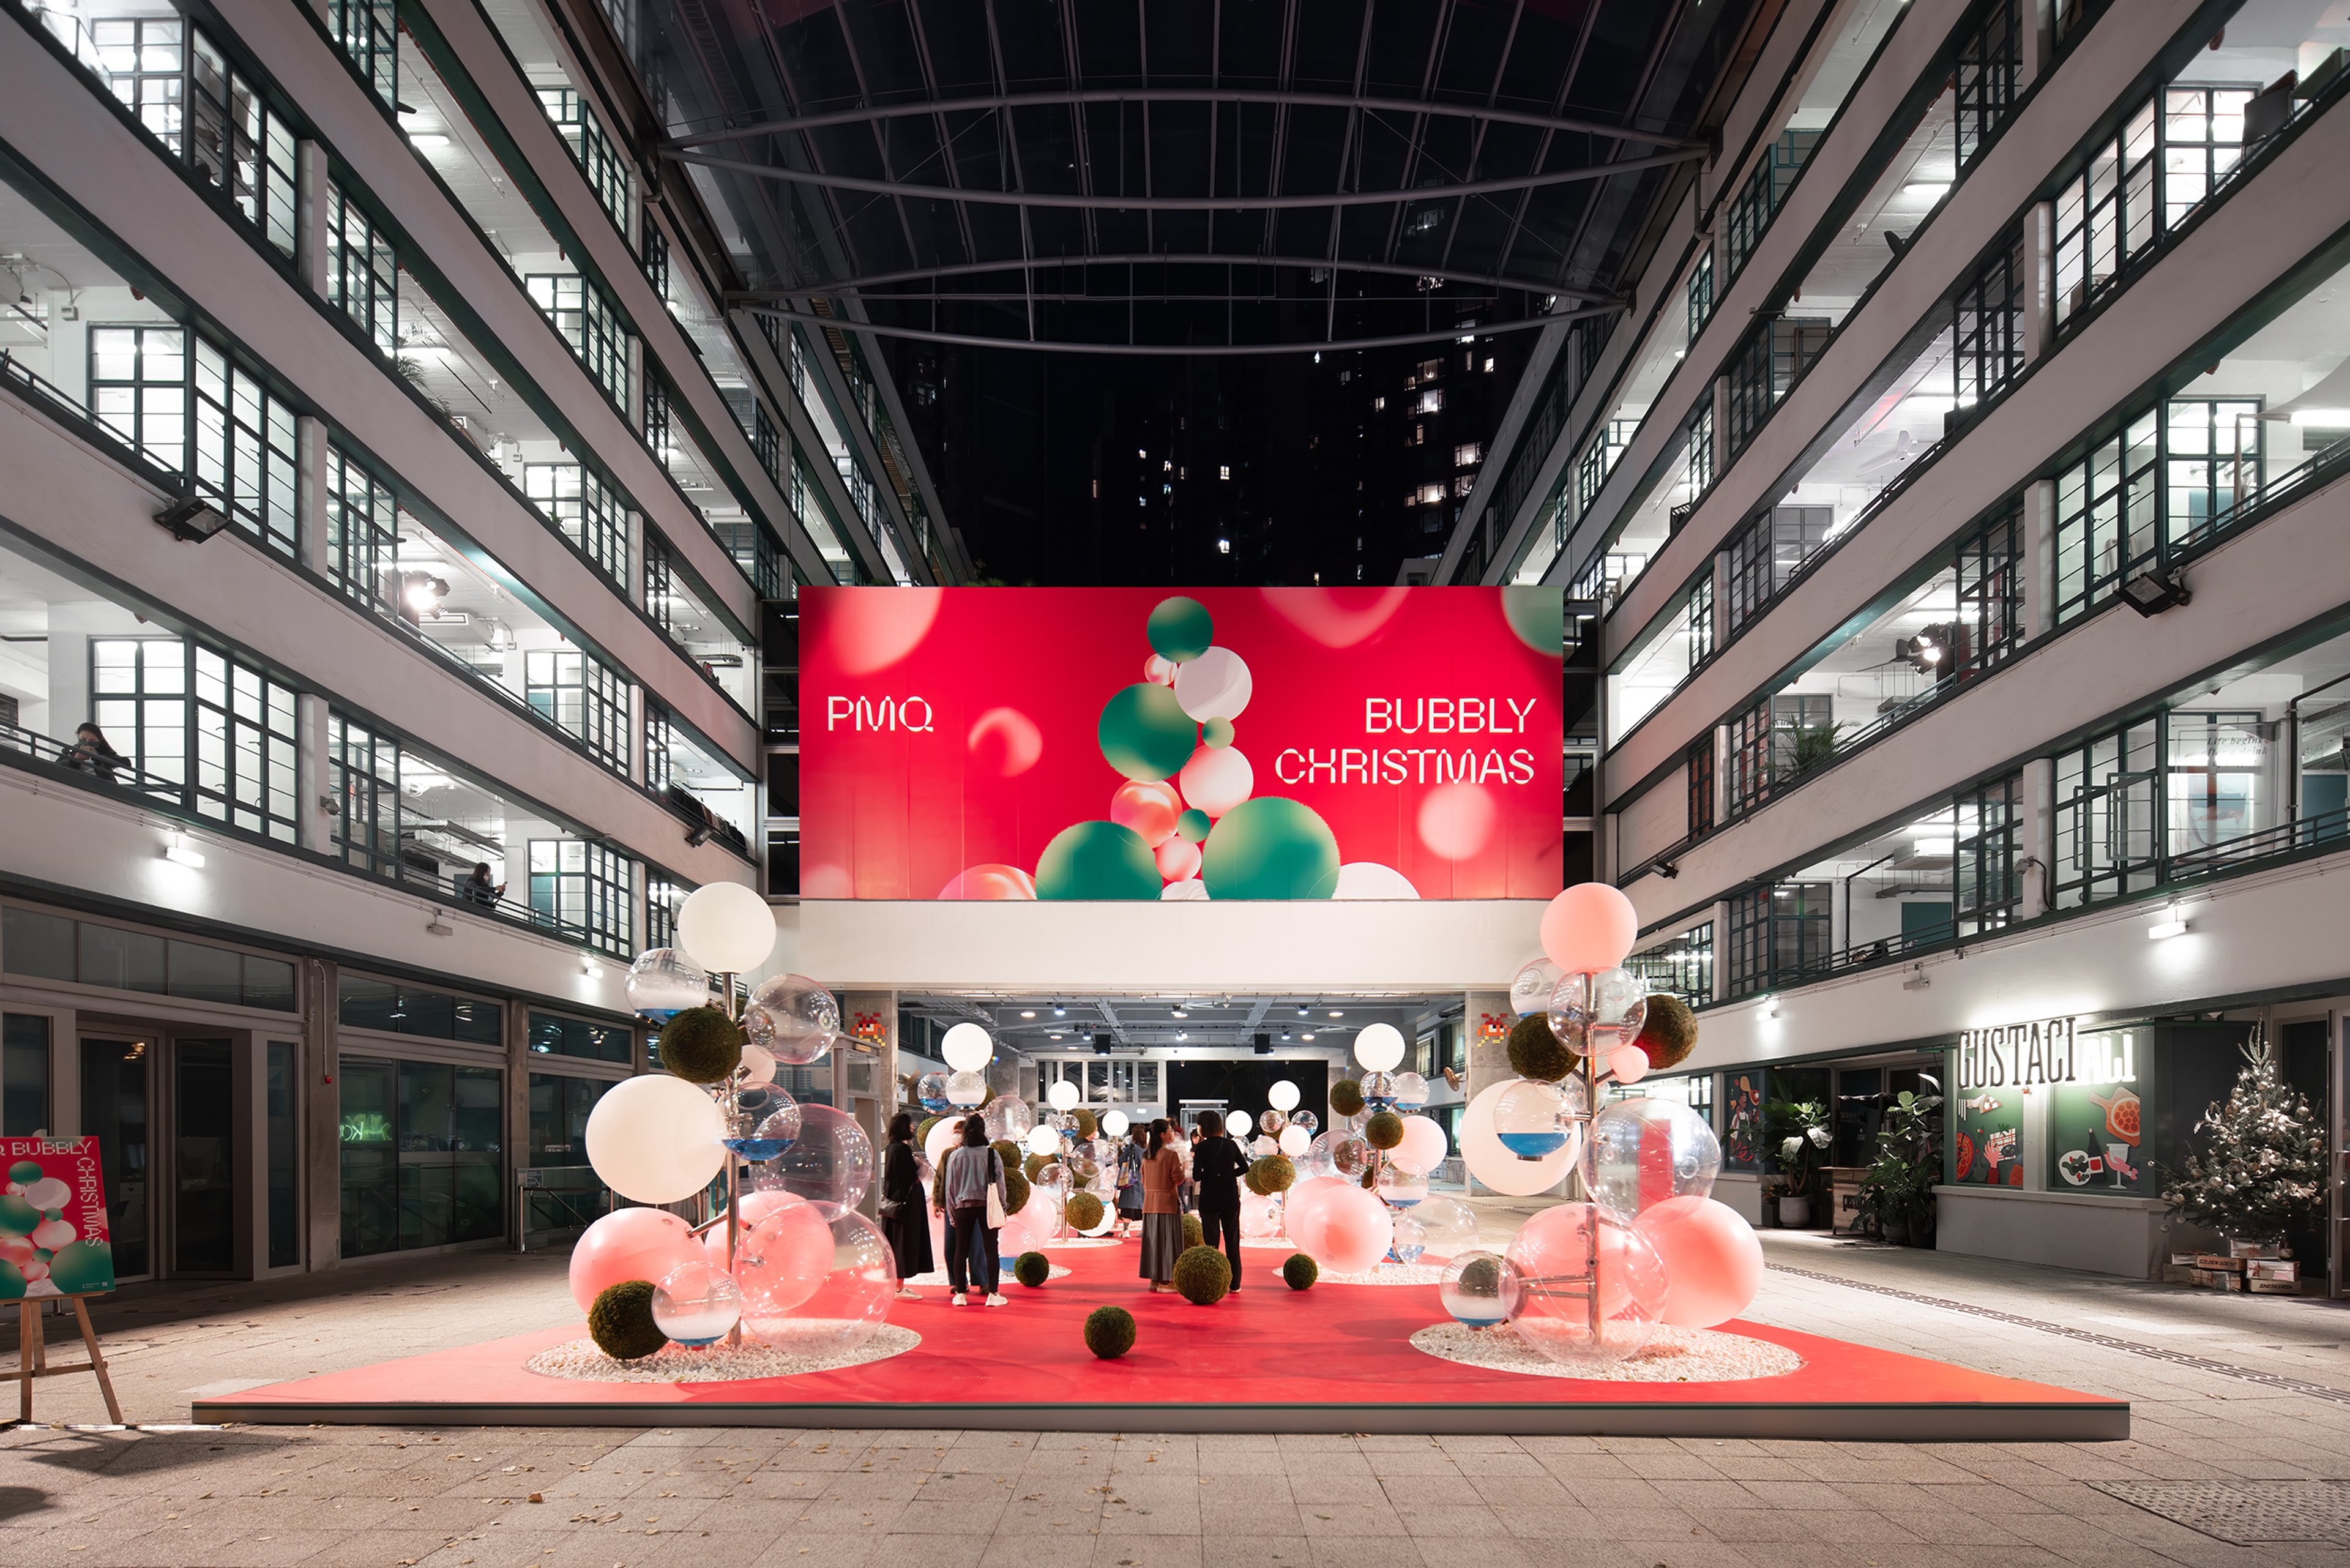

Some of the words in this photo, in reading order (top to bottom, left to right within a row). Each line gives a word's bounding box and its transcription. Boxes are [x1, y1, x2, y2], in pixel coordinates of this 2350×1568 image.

[828, 696, 934, 733] PMQ
[1365, 698, 1537, 733] BUBBLY
[1275, 749, 1535, 785] CHRISTMAS
[1957, 1017, 2076, 1088] GUSTACI
[12, 1141, 92, 1156] BUBBLY
[76, 1157, 103, 1247] CHRISTMAS
